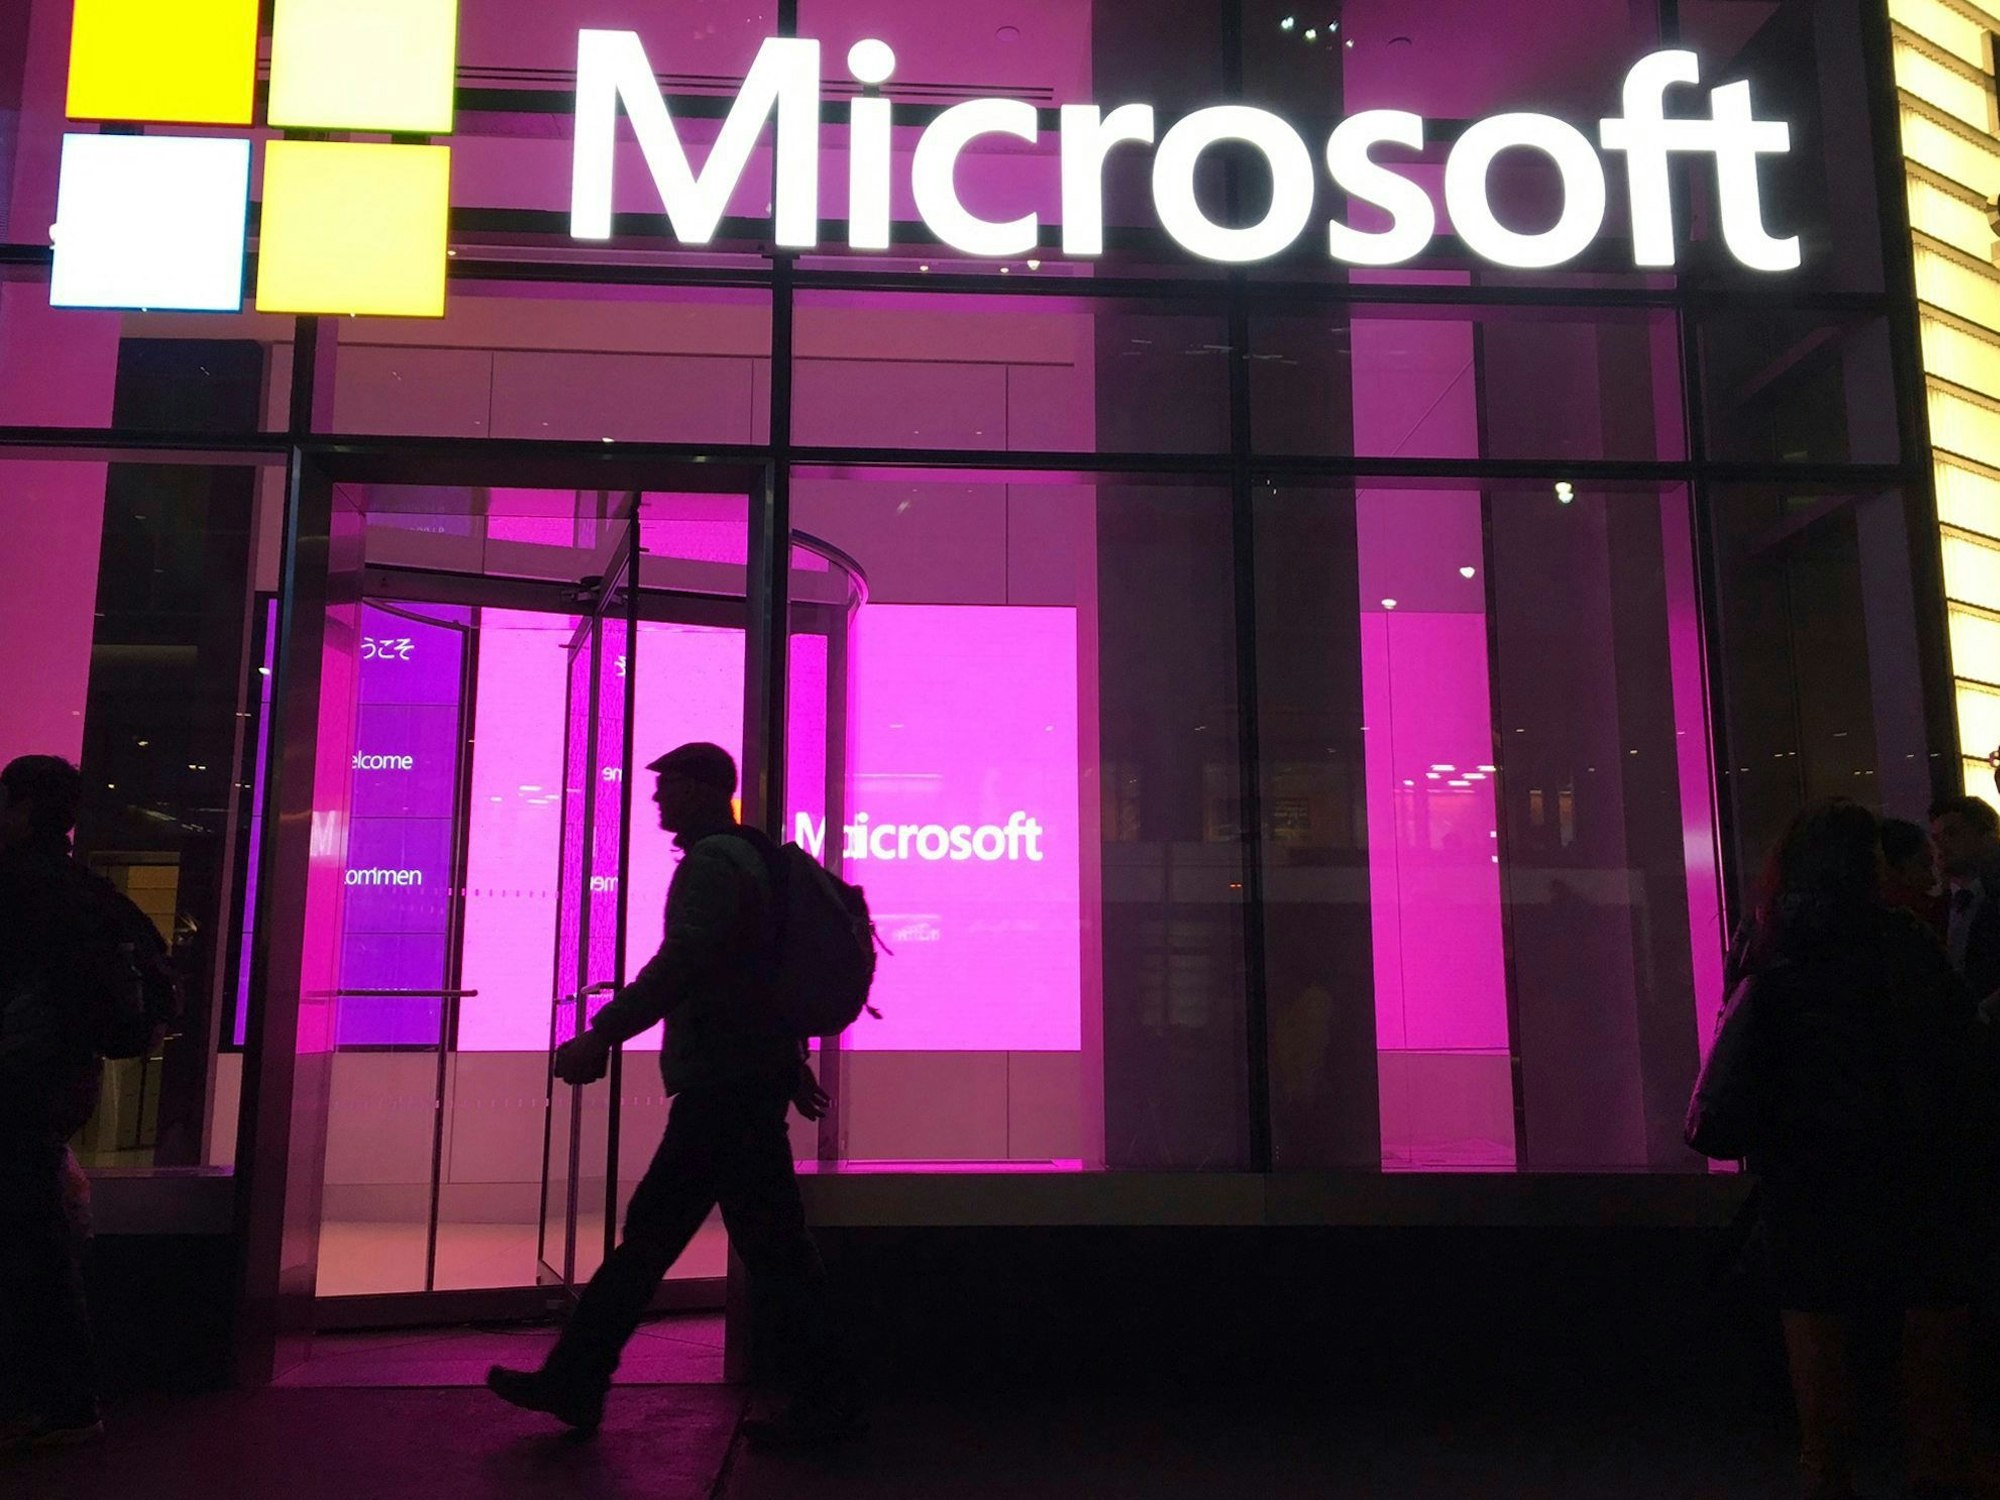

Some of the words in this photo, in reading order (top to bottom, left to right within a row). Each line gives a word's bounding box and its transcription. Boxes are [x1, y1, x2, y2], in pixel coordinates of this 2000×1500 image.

[569, 28, 1801, 273] Microsoft
[360, 636, 415, 660] うこそ
[795, 811, 1044, 861] Microsoft
